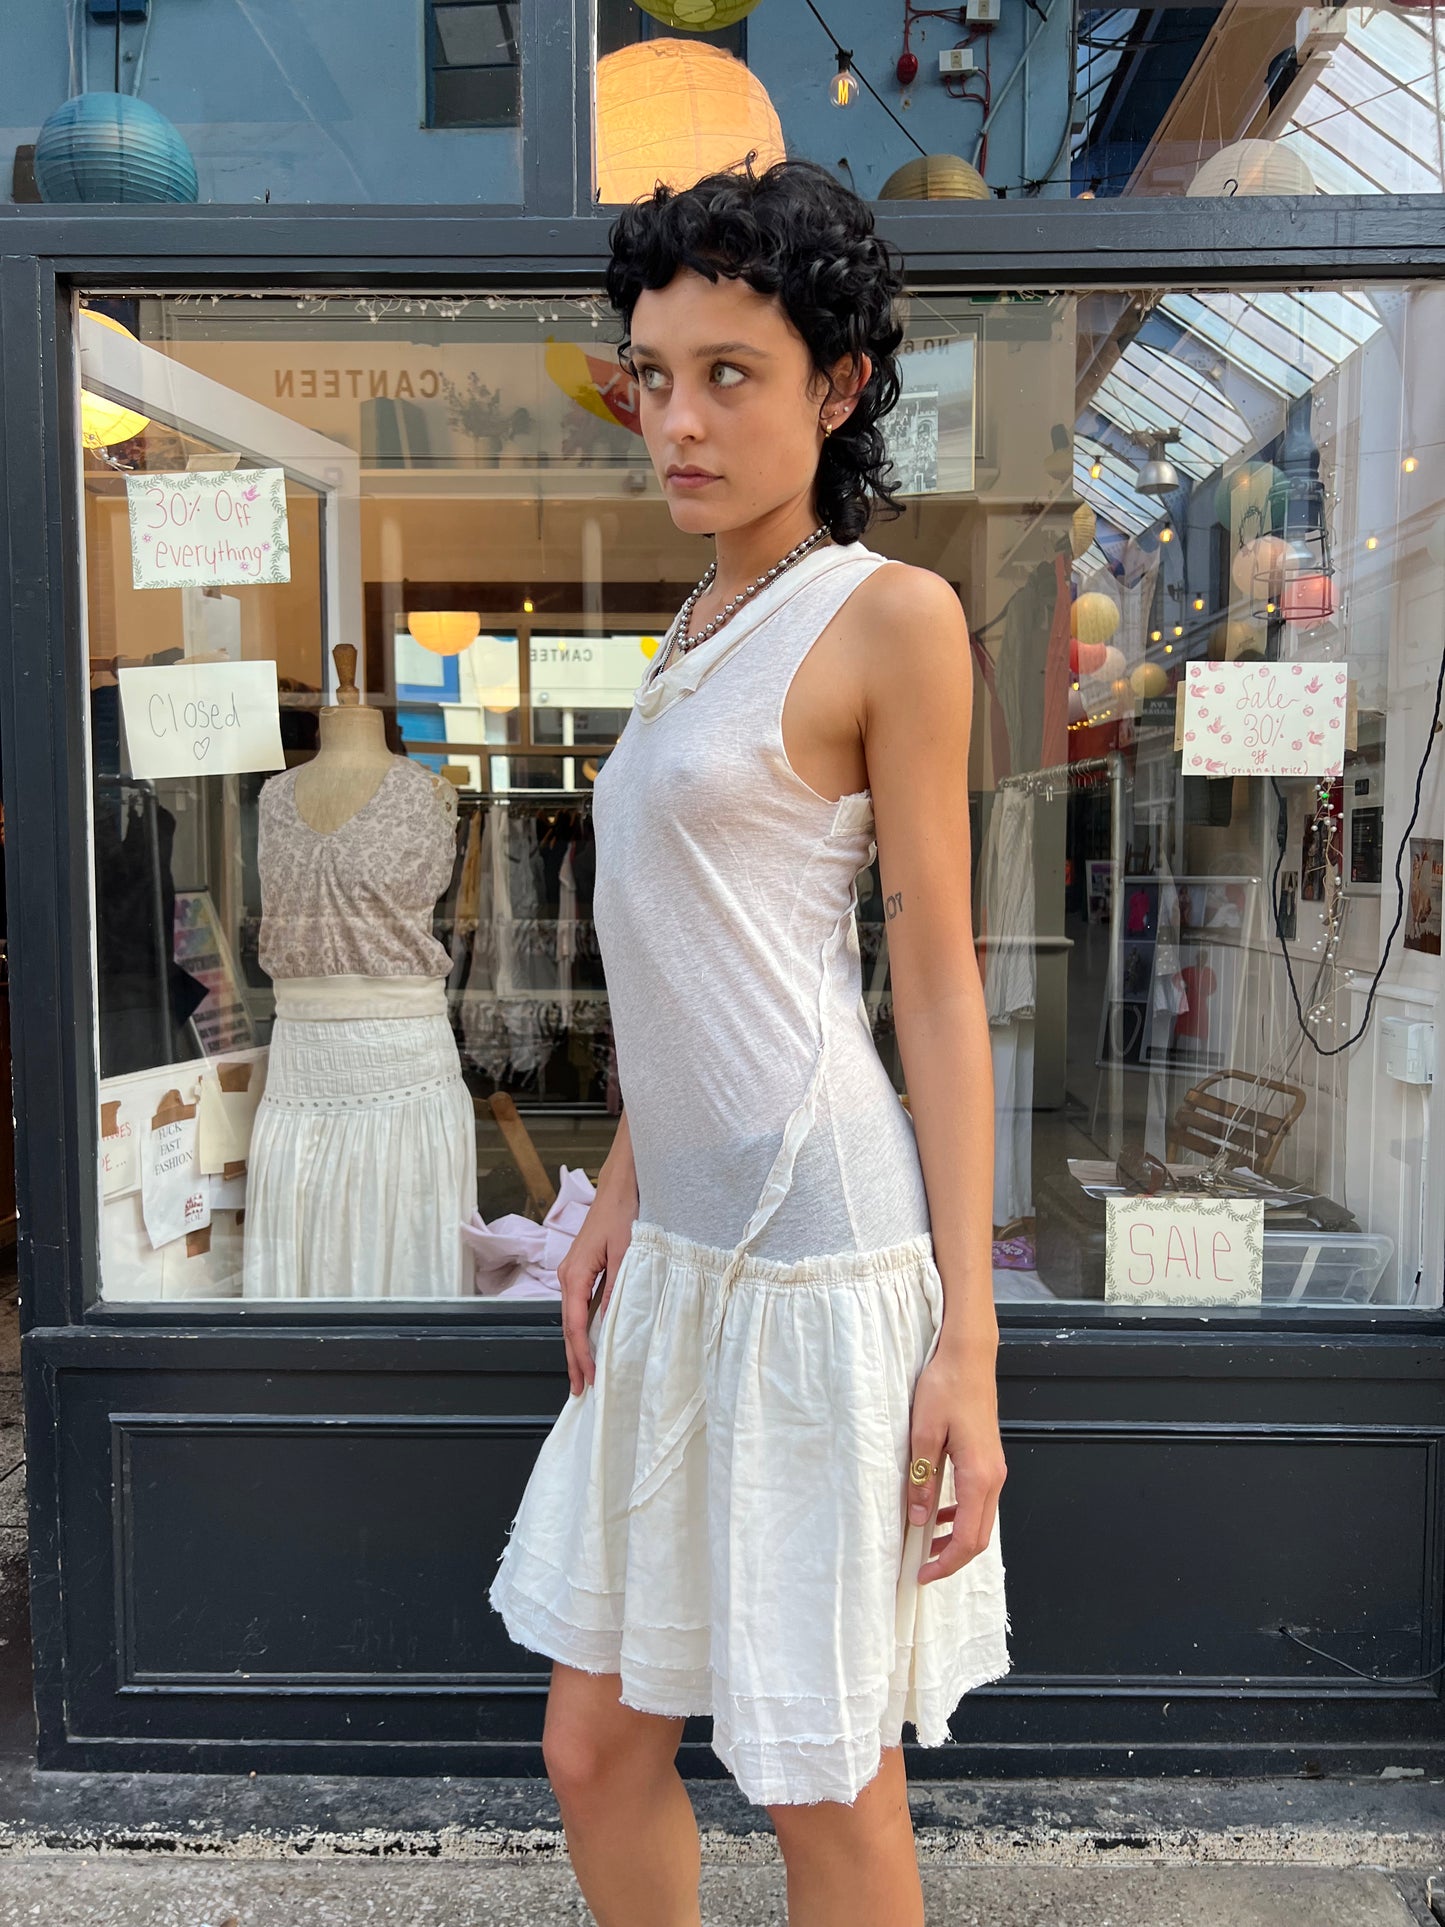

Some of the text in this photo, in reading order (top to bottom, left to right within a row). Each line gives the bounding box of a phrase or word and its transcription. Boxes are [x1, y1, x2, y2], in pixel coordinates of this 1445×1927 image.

[145, 488, 201, 529] 30%
[155, 539, 262, 577] everything
[1236, 673, 1301, 710] Sale
[148, 691, 241, 738] Closed
[1243, 713, 1286, 748] 30%
[1251, 749, 1268, 766] off
[154, 1150, 193, 1176] FASHION
[159, 1137, 181, 1156] FAST
